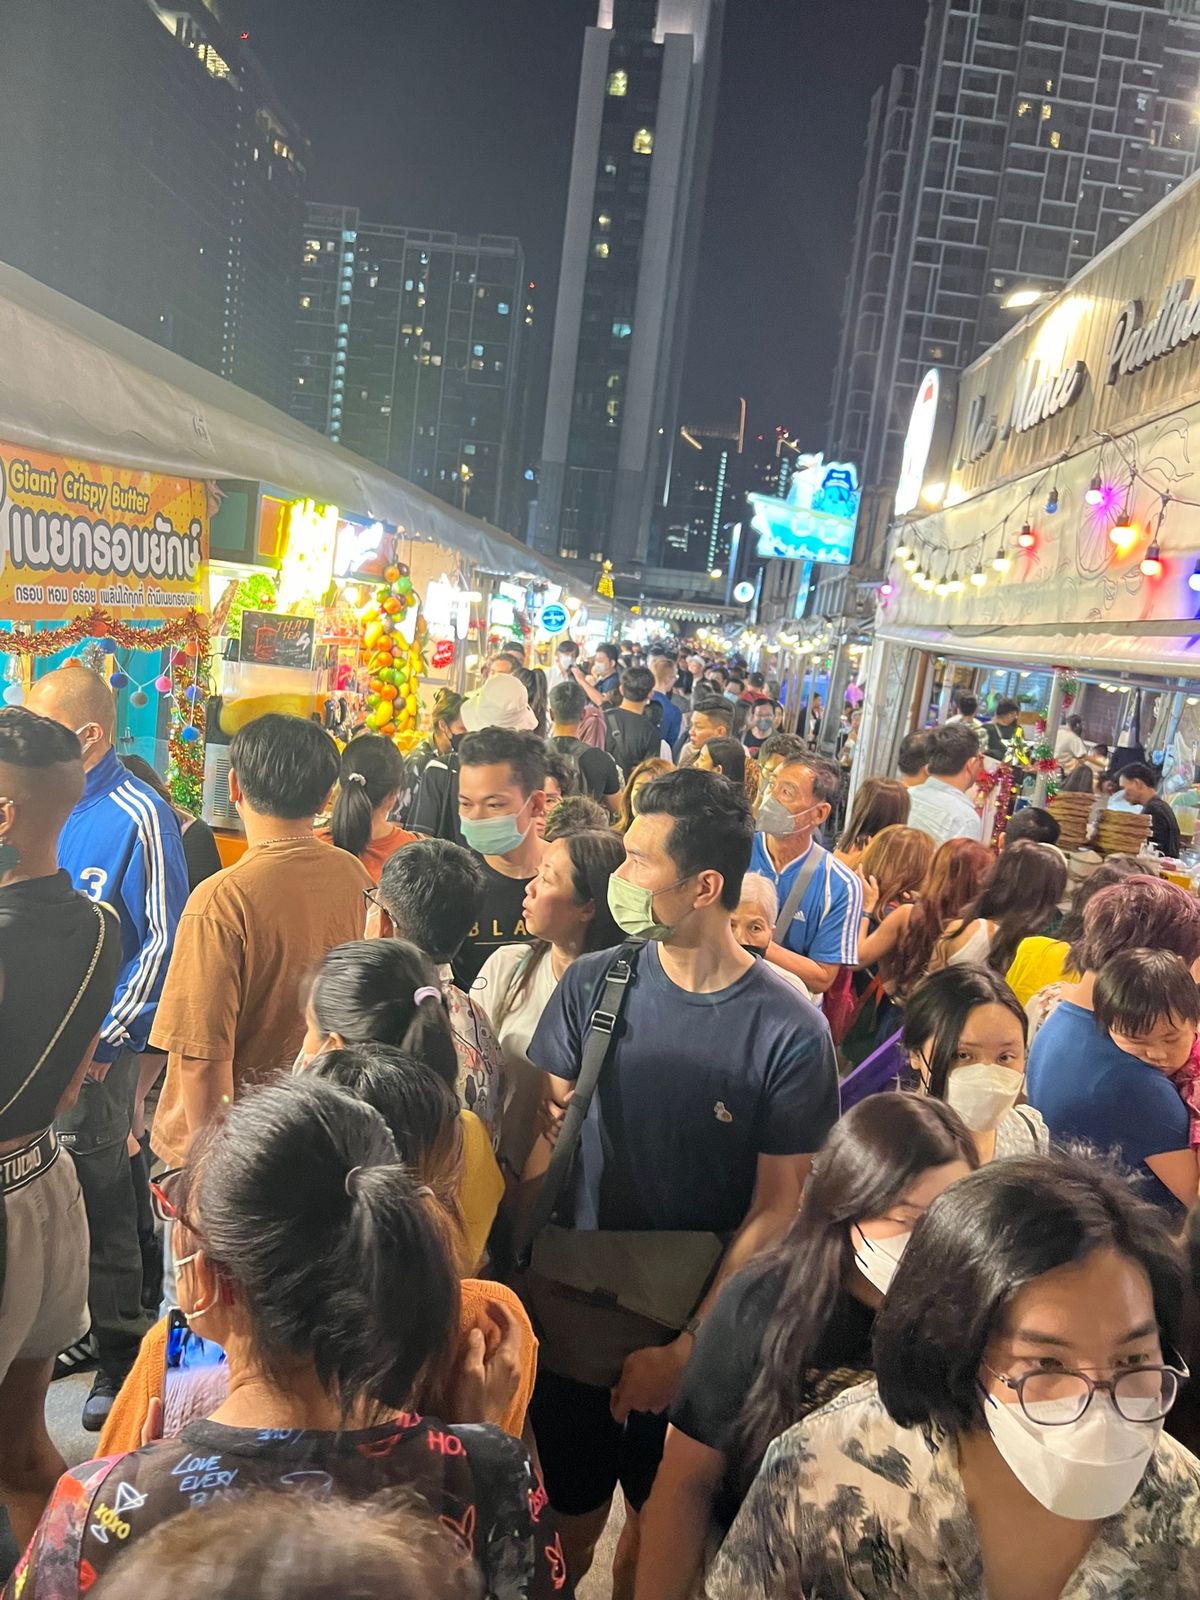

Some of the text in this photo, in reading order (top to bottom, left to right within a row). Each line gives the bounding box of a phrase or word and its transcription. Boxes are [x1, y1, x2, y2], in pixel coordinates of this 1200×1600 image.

[9, 460, 149, 513] Giant Crispy Butter
[11, 508, 203, 580] เนยกรอบยักษ์
[16, 585, 43, 602] กรอบ
[48, 586, 68, 603] หอม
[72, 582, 97, 605] อร่อย
[80, 866, 108, 902] 3
[171, 1453, 222, 1475] LOVE
[179, 1468, 239, 1492] EVERY
